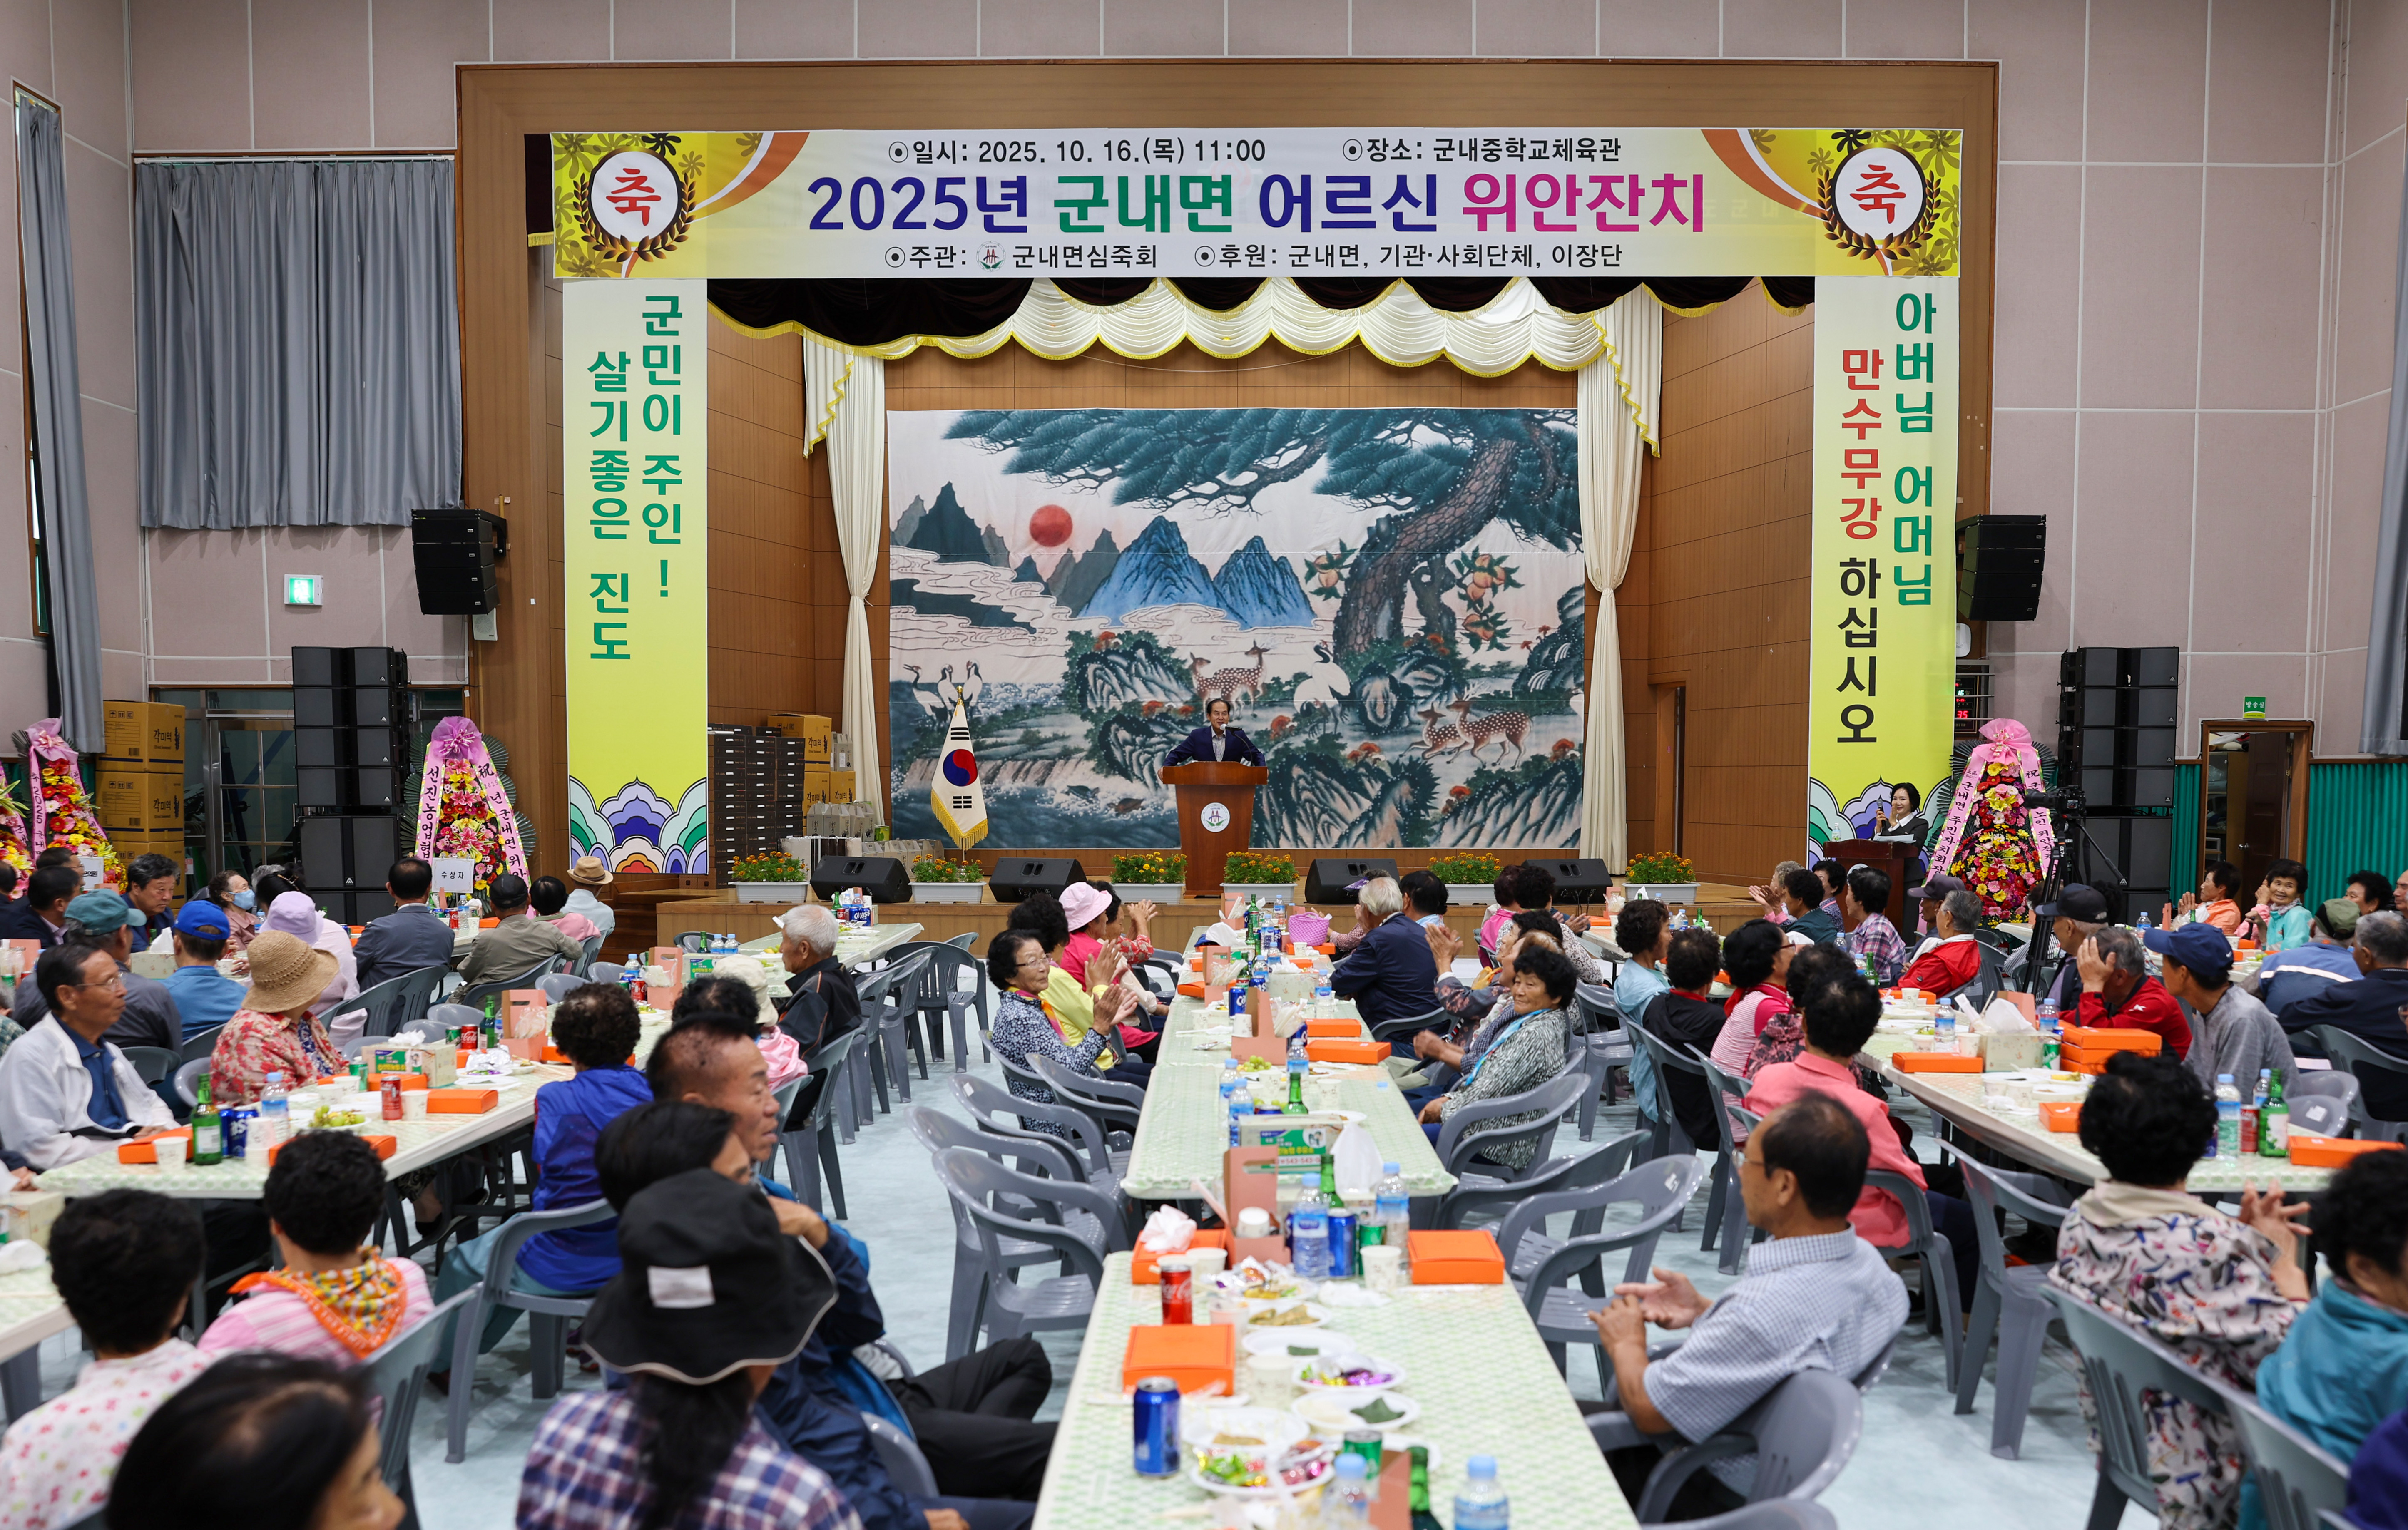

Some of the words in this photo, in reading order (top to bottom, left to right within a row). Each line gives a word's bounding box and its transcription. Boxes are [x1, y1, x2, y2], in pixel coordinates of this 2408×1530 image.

[913, 141, 967, 164] 일시:
[979, 141, 1045, 162] 2025.
[1057, 141, 1092, 162] 10.
[1196, 140, 1265, 161] 11:00
[1367, 138, 1421, 162] 장소:
[1434, 138, 1621, 162] 군내중학교체육관
[607, 169, 661, 225] 축
[808, 176, 1027, 233] 2025년
[1055, 175, 1231, 232] 군내면
[1260, 174, 1436, 232] 어르신
[1463, 174, 1703, 232] 위안잔치
[1851, 165, 1906, 223] 축
[910, 246, 965, 268] 주관:
[1013, 245, 1156, 268] 군내면심죽회
[1220, 245, 1276, 267] 후원:
[1289, 245, 1368, 268] 군내면,
[1553, 245, 1622, 267] 이장단
[643, 296, 682, 435] 군민이
[1896, 294, 1936, 432] 아버님
[588, 352, 630, 539] 살기좋은
[1841, 350, 1883, 539] 만수무강
[1894, 467, 1932, 605] 어머님
[590, 573, 630, 659] 진도
[1836, 558, 1881, 743] 하십시오
[154, 729, 172, 743] 각미역
[808, 737, 822, 748] 각미역
[478, 763, 495, 778] 祝
[2025, 770, 2040, 779] 祝
[154, 798, 171, 812] 각미역
[807, 792, 820, 803] 각미역
[835, 790, 847, 802] 각미역
[1955, 782, 1974, 811] 군내면
[420, 766, 439, 861] 선진농업협
